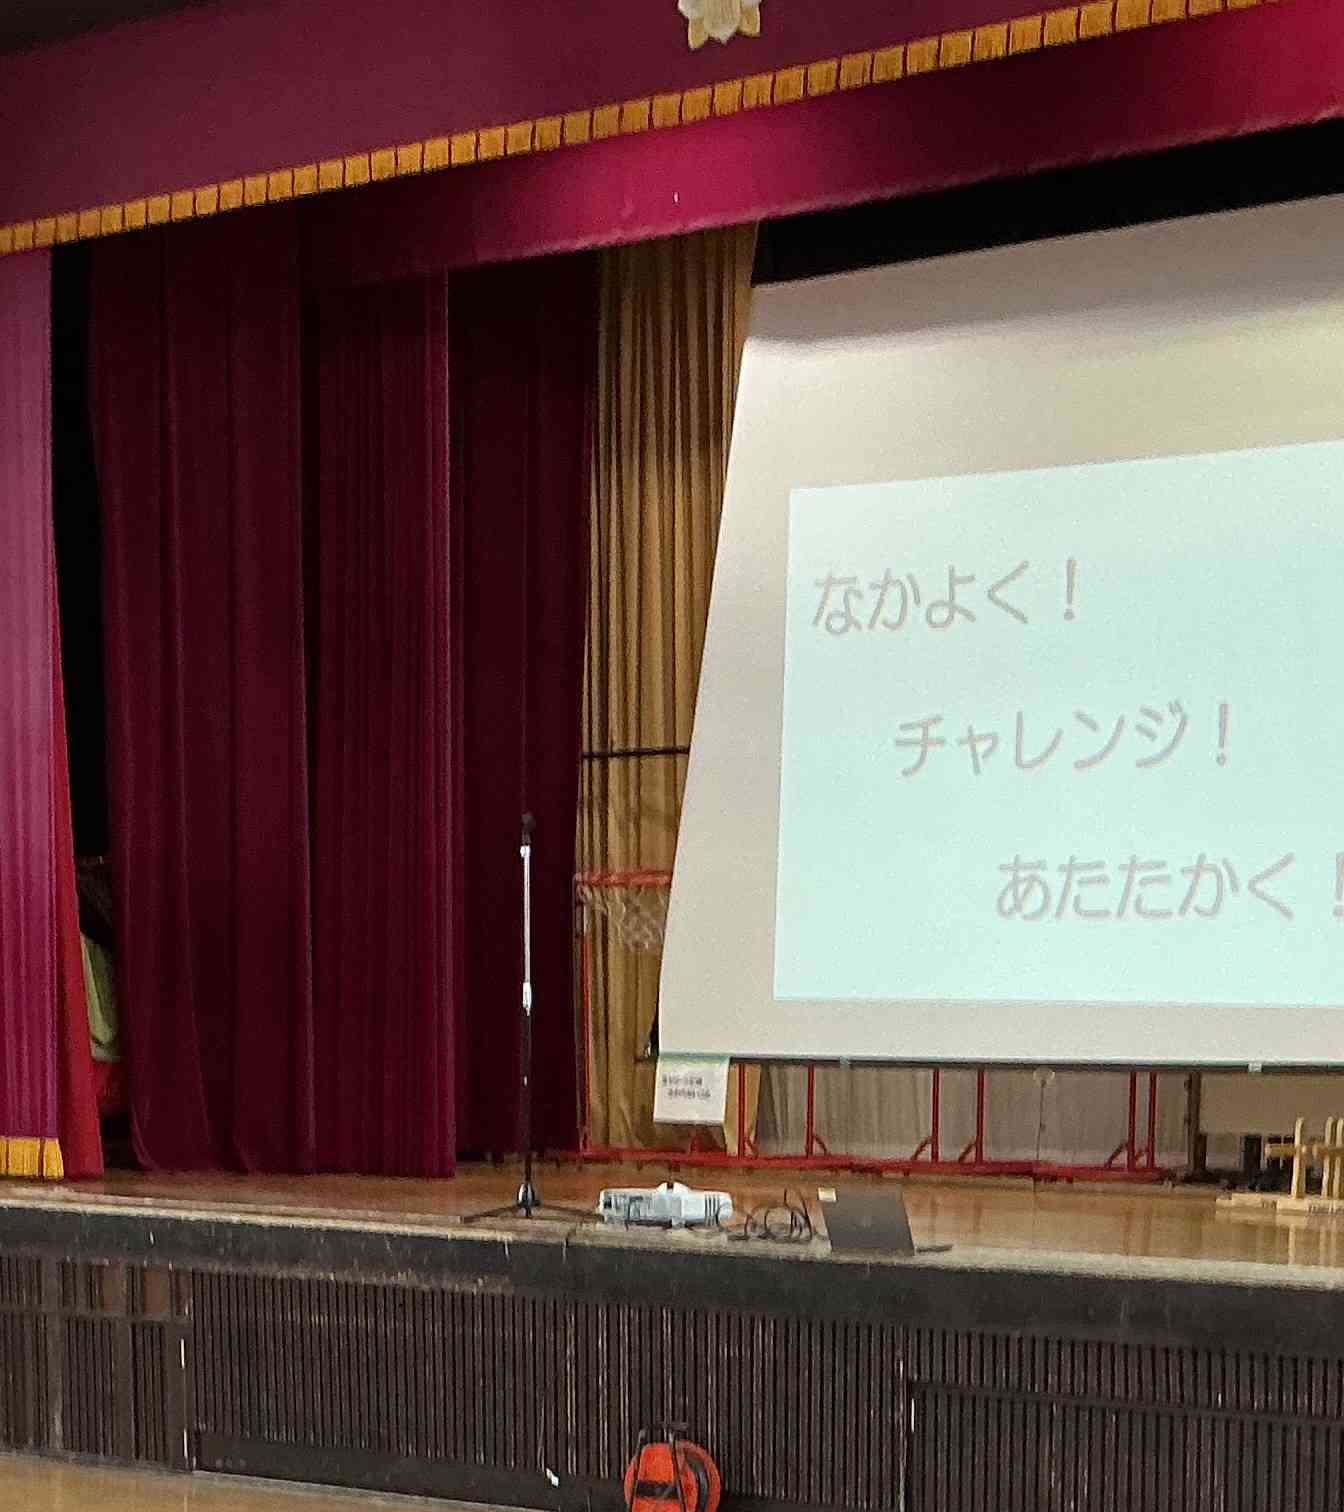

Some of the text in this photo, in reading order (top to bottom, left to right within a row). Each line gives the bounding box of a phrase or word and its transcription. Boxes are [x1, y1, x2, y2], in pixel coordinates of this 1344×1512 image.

[810, 557, 1077, 636] なかよく！
[893, 699, 1230, 778] チャレンジ！
